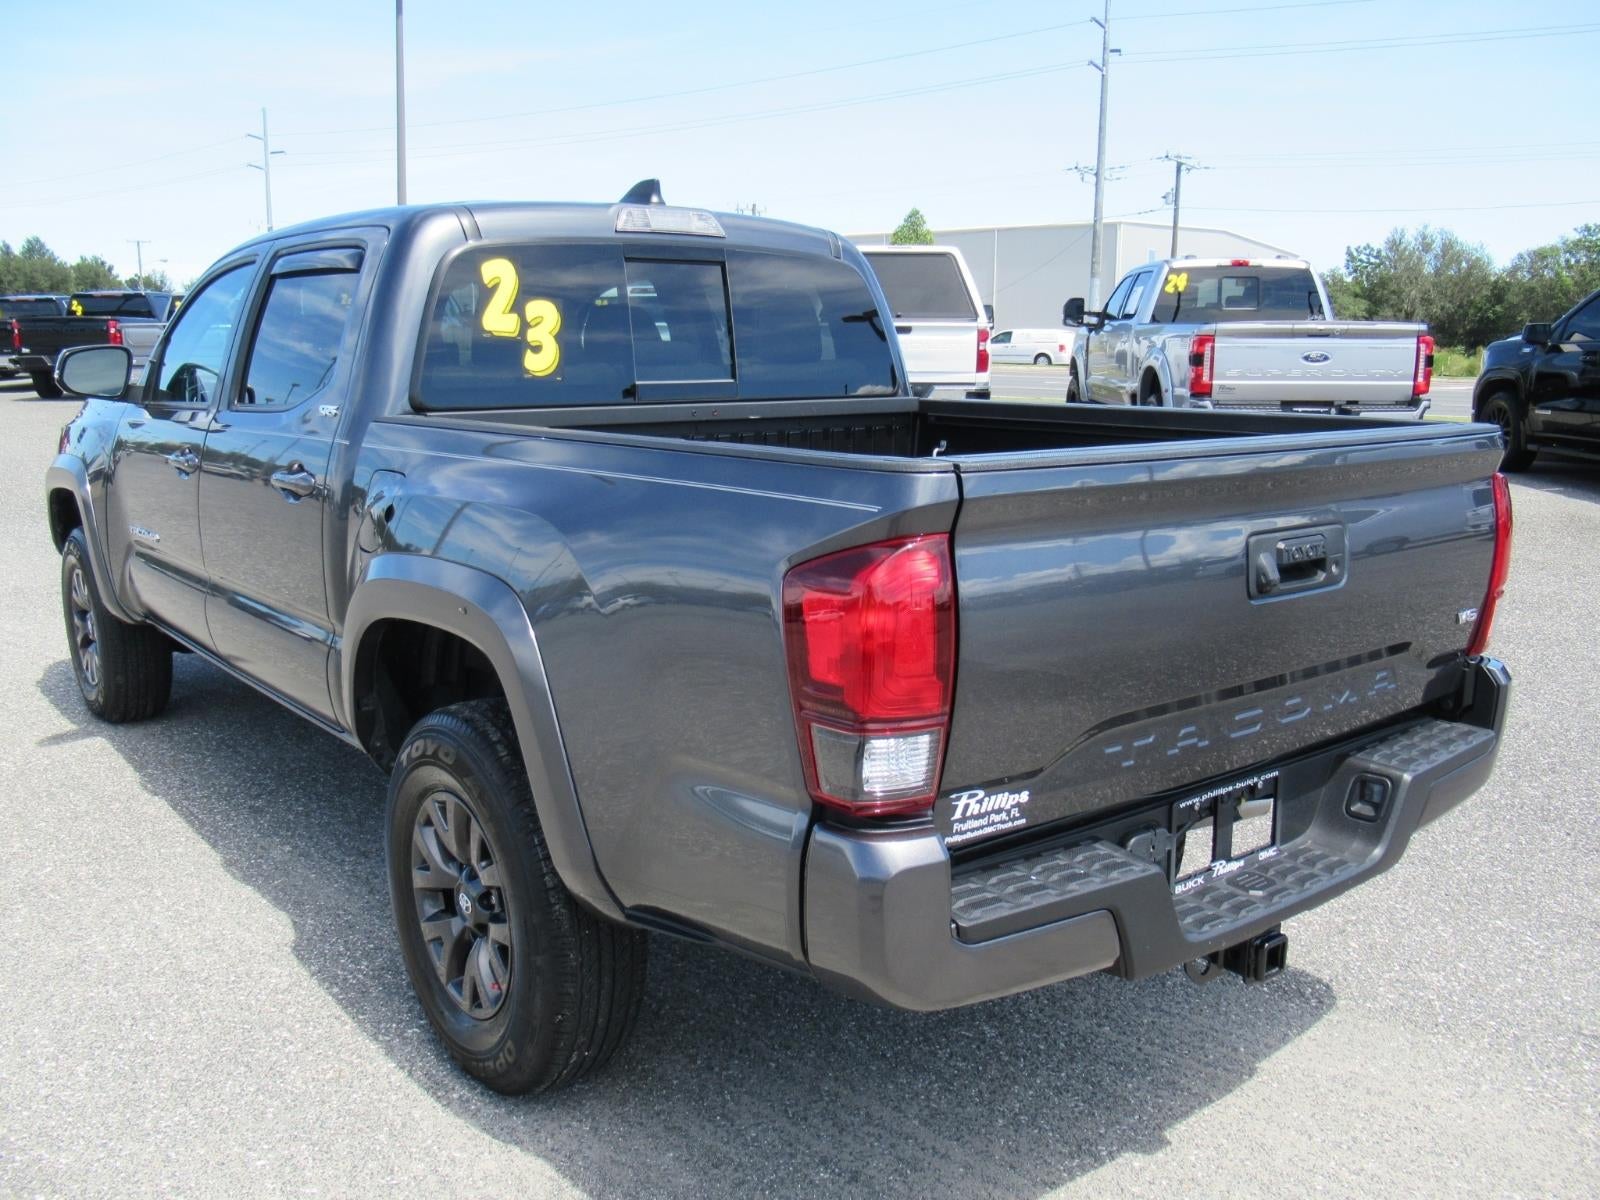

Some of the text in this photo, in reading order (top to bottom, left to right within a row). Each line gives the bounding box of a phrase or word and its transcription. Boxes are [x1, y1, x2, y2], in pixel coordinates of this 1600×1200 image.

[1103, 670, 1398, 768] TACOMA
[949, 789, 1030, 821] Phillips
[1179, 769, 1279, 809] www.phillips-buick.com
[953, 808, 1020, 833] Fruitland Park, FL
[1175, 876, 1205, 893] BUICK
[1259, 847, 1278, 860] GMC
